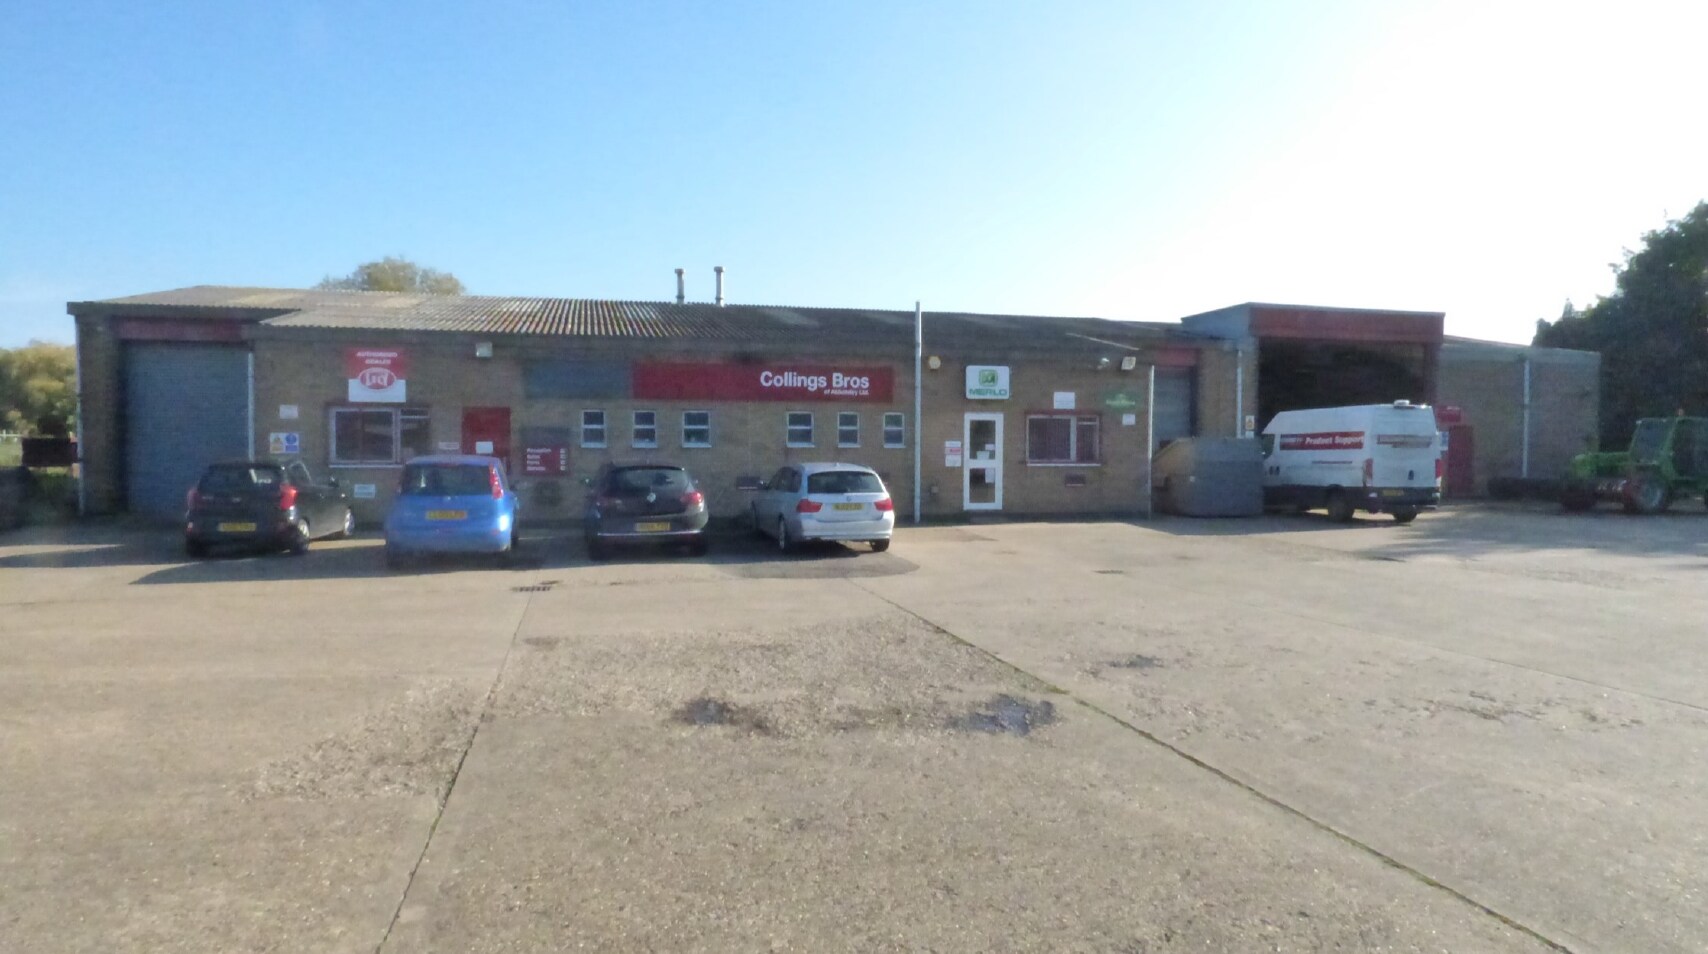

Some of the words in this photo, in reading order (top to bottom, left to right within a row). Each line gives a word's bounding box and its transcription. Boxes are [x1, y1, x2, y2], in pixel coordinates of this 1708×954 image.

[760, 371, 828, 392] Collings
[832, 372, 870, 389] Bros
[969, 388, 1008, 396] MERLO
[1334, 435, 1364, 445] Support
